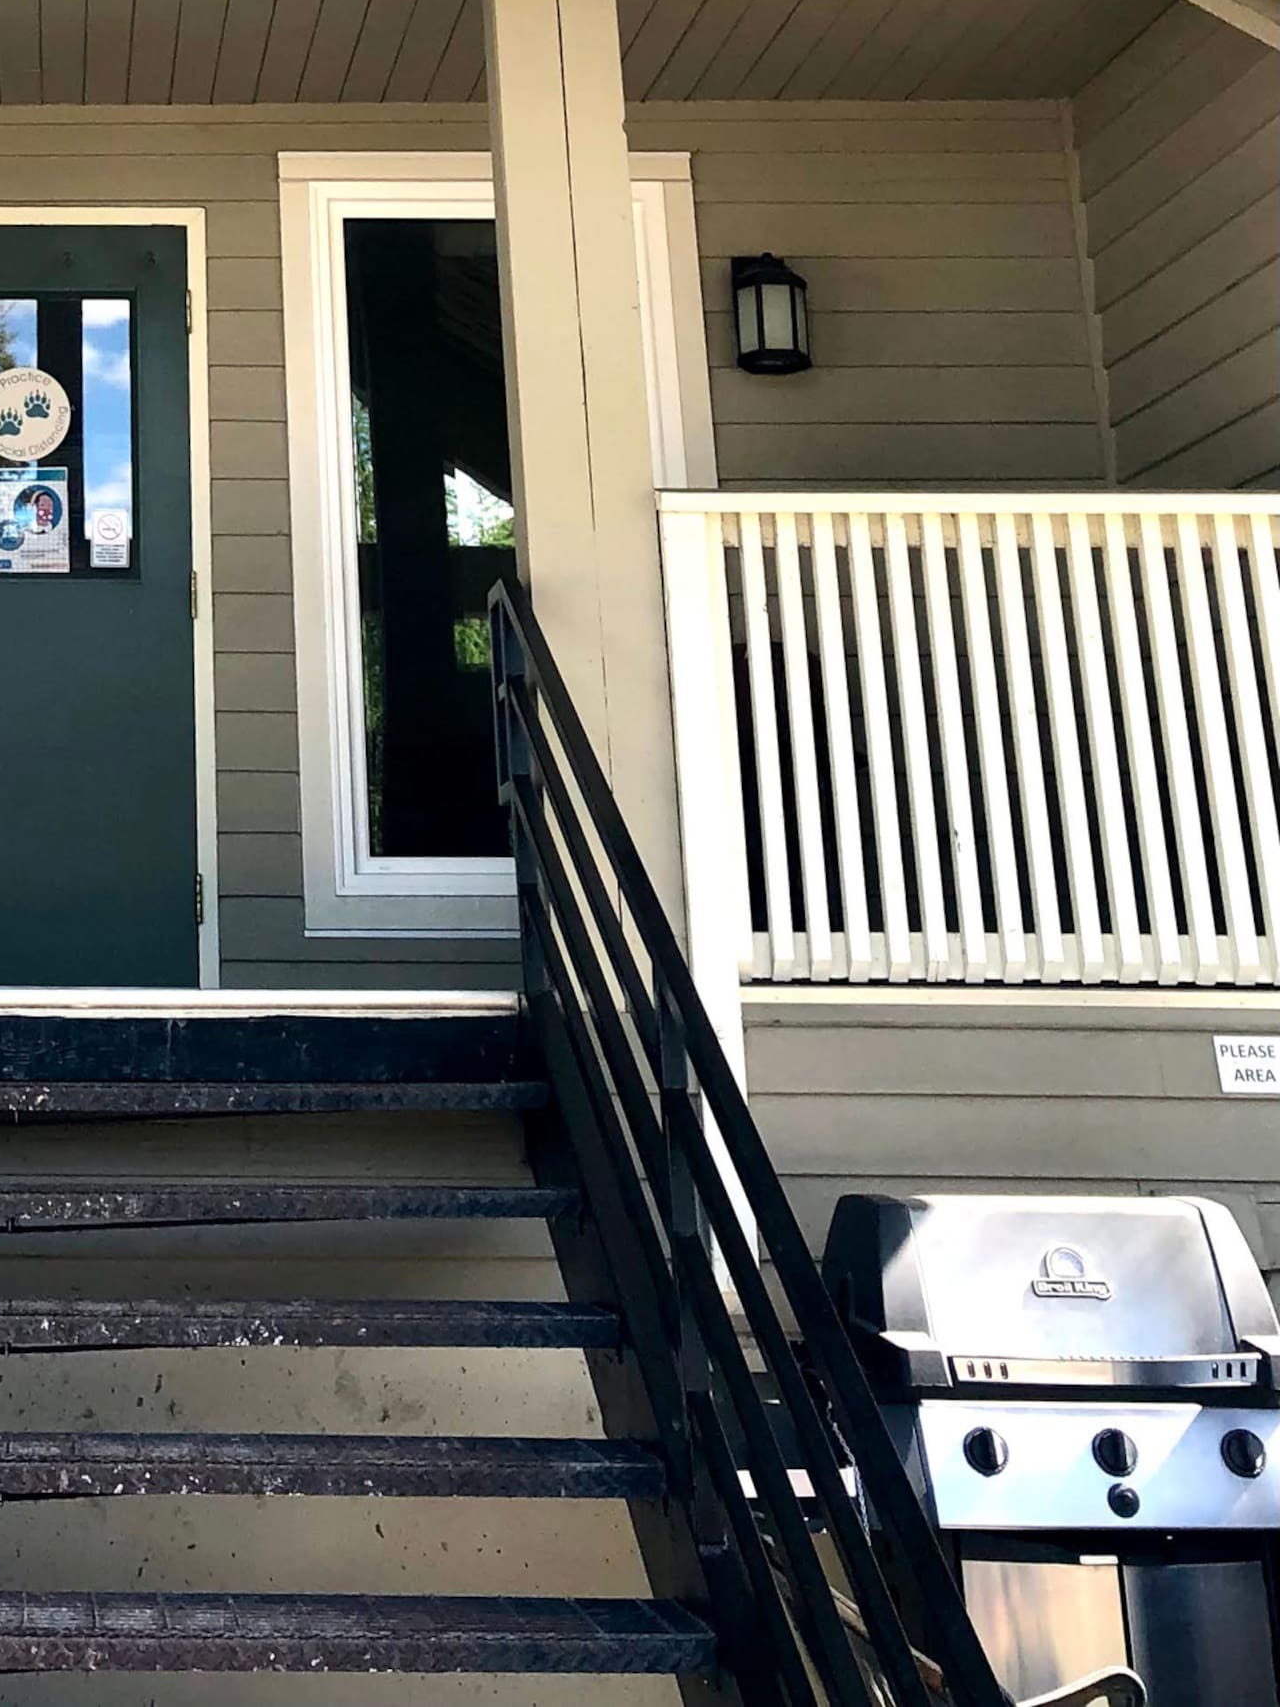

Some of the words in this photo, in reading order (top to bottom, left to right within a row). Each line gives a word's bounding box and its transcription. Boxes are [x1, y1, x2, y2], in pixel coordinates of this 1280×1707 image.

[0, 372, 52, 388] Practice
[28, 405, 69, 456] Distancing
[1219, 1044, 1276, 1059] PLEASE
[1234, 1068, 1277, 1082] AREA
